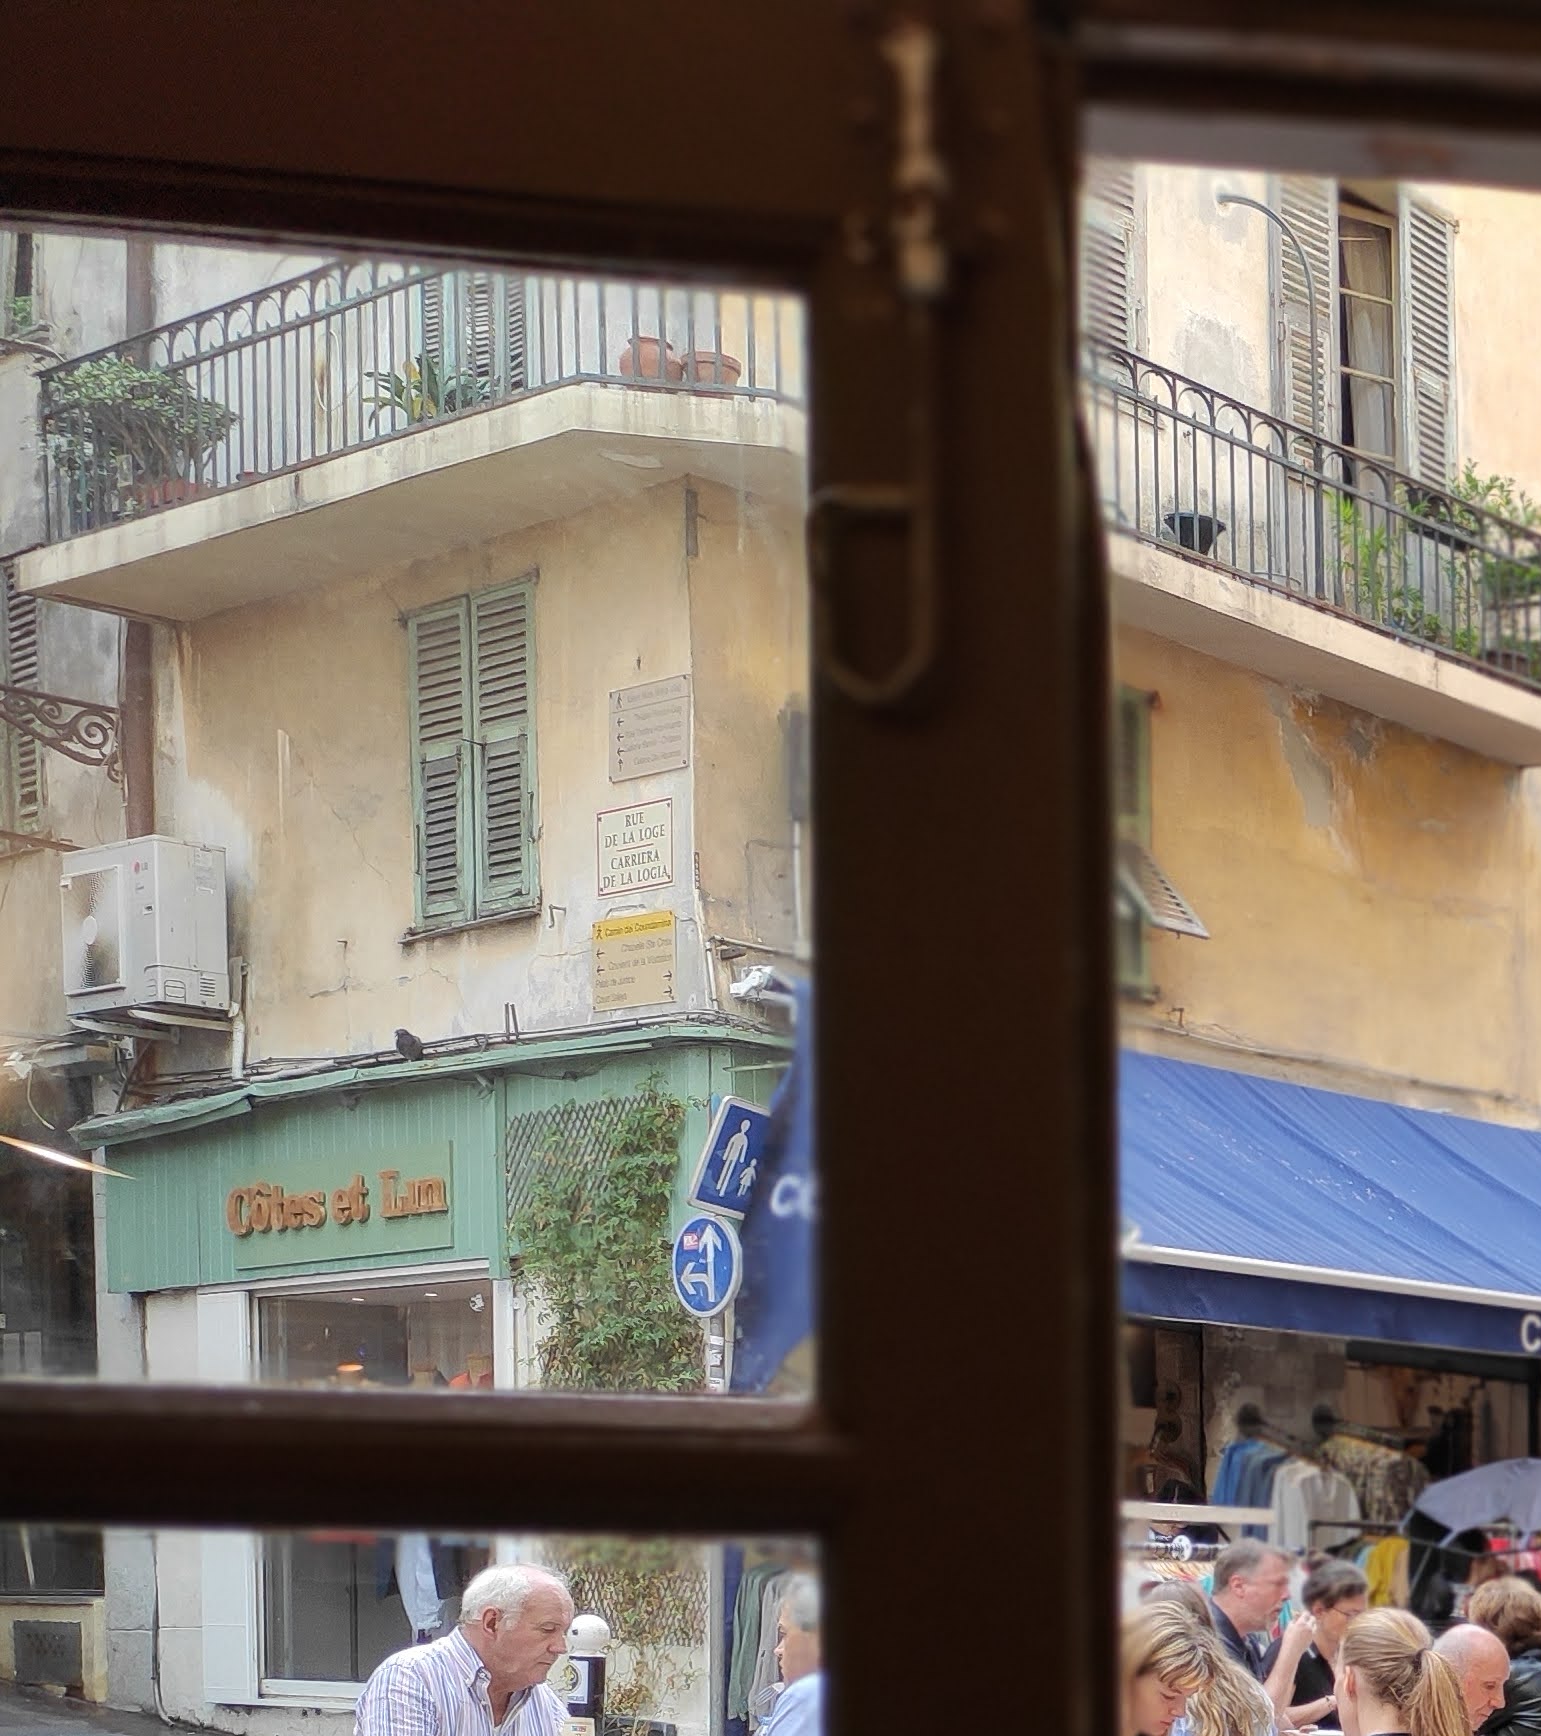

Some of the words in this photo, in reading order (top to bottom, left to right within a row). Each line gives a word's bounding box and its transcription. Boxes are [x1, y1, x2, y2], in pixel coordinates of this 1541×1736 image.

[625, 812, 645, 828] RUE
[604, 834, 618, 848] DE
[622, 831, 635, 845] LA
[639, 824, 665, 842] LOGE
[611, 849, 660, 870] CARRIERA
[603, 875, 616, 889] DE
[620, 871, 633, 885] LA
[638, 864, 669, 882] LOGIA
[226, 1181, 326, 1237] Côtes
[331, 1174, 370, 1225] et
[379, 1169, 449, 1219] Lin
